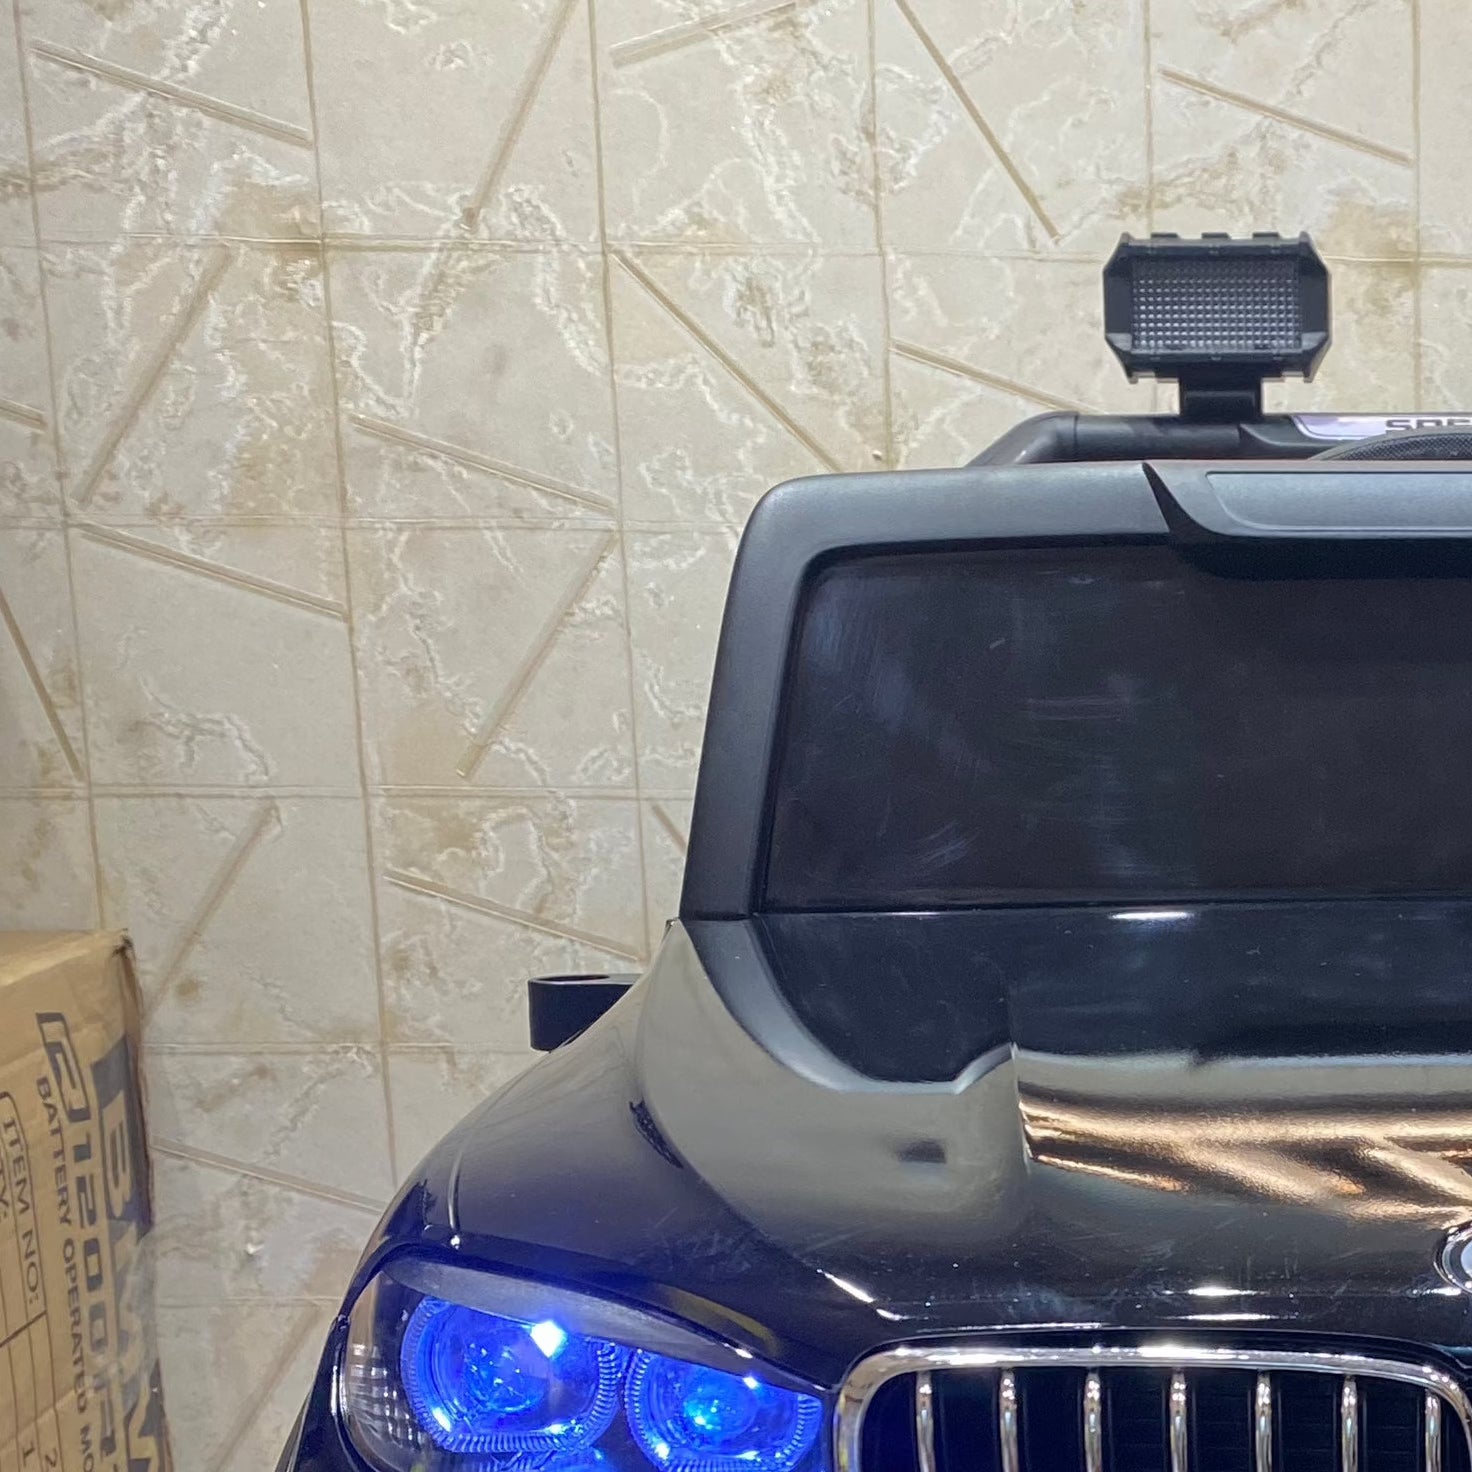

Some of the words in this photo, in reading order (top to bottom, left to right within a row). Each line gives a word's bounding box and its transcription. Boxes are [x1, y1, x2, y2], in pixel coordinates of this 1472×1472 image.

[2, 1117, 30, 1215] ITEM
[22, 1229, 40, 1305] NO:
[36, 1076, 72, 1226] BATTERY
[62, 1237, 87, 1414] OPERATED
